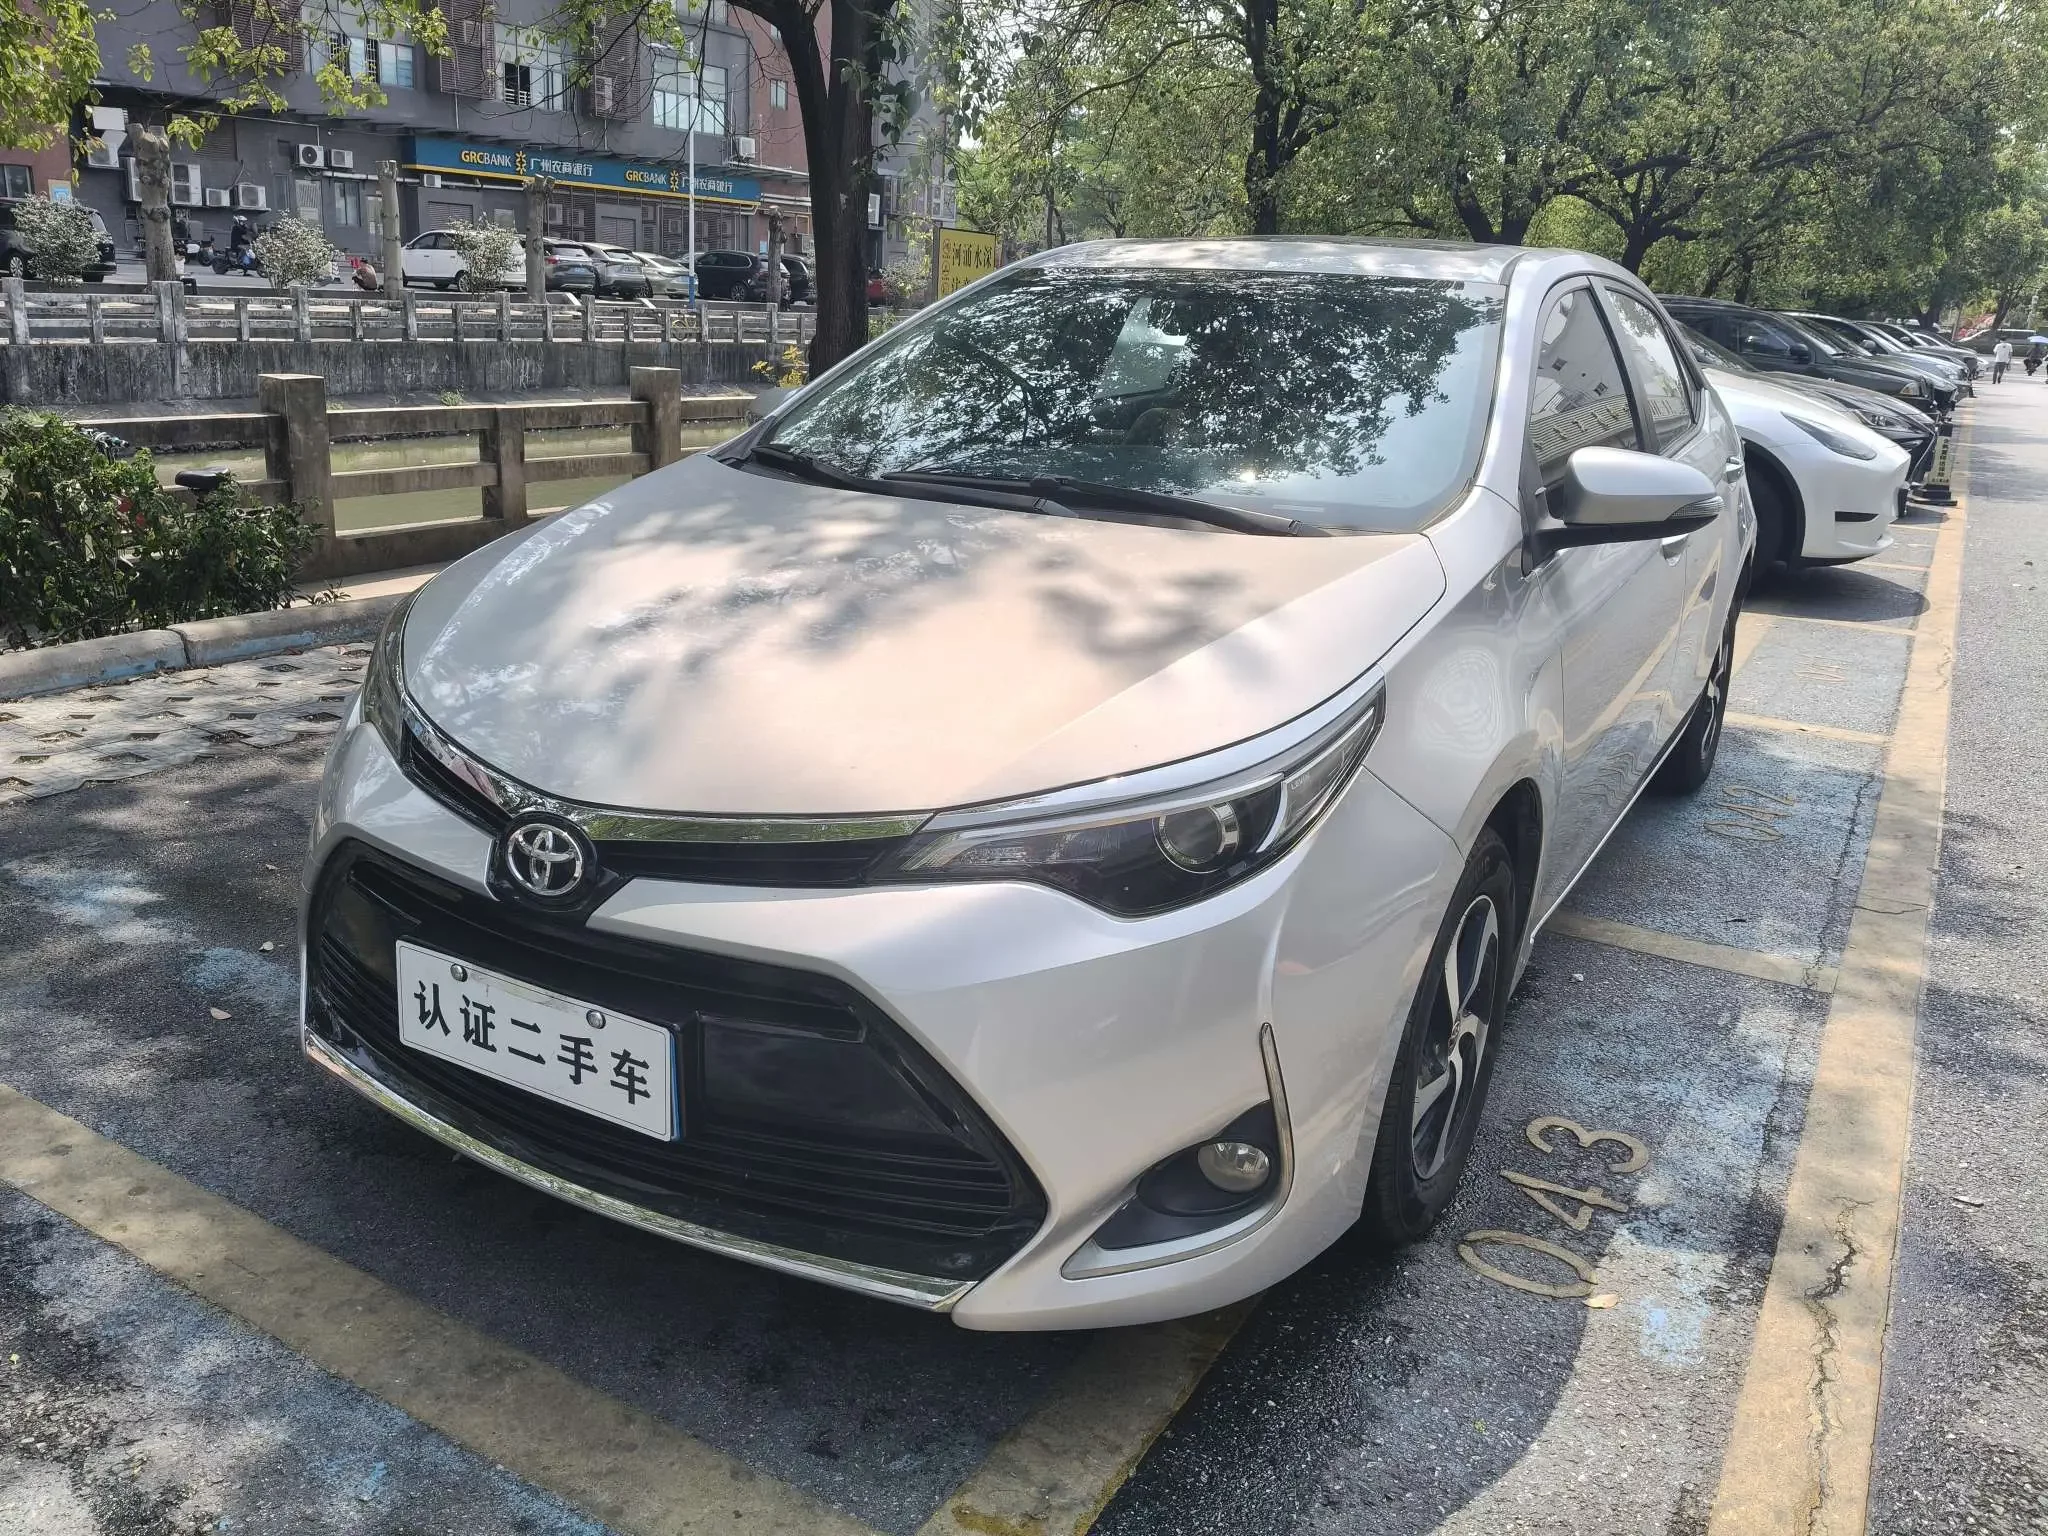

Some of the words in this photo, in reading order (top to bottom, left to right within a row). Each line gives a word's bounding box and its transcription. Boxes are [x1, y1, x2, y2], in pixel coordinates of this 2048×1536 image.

[461, 150, 512, 168] GRCBANK
[530, 157, 593, 177] 广州农商银行
[625, 169, 667, 185] GRCBANK
[413, 980, 652, 1105] 认证二手车
[1457, 1116, 1649, 1298] 043
